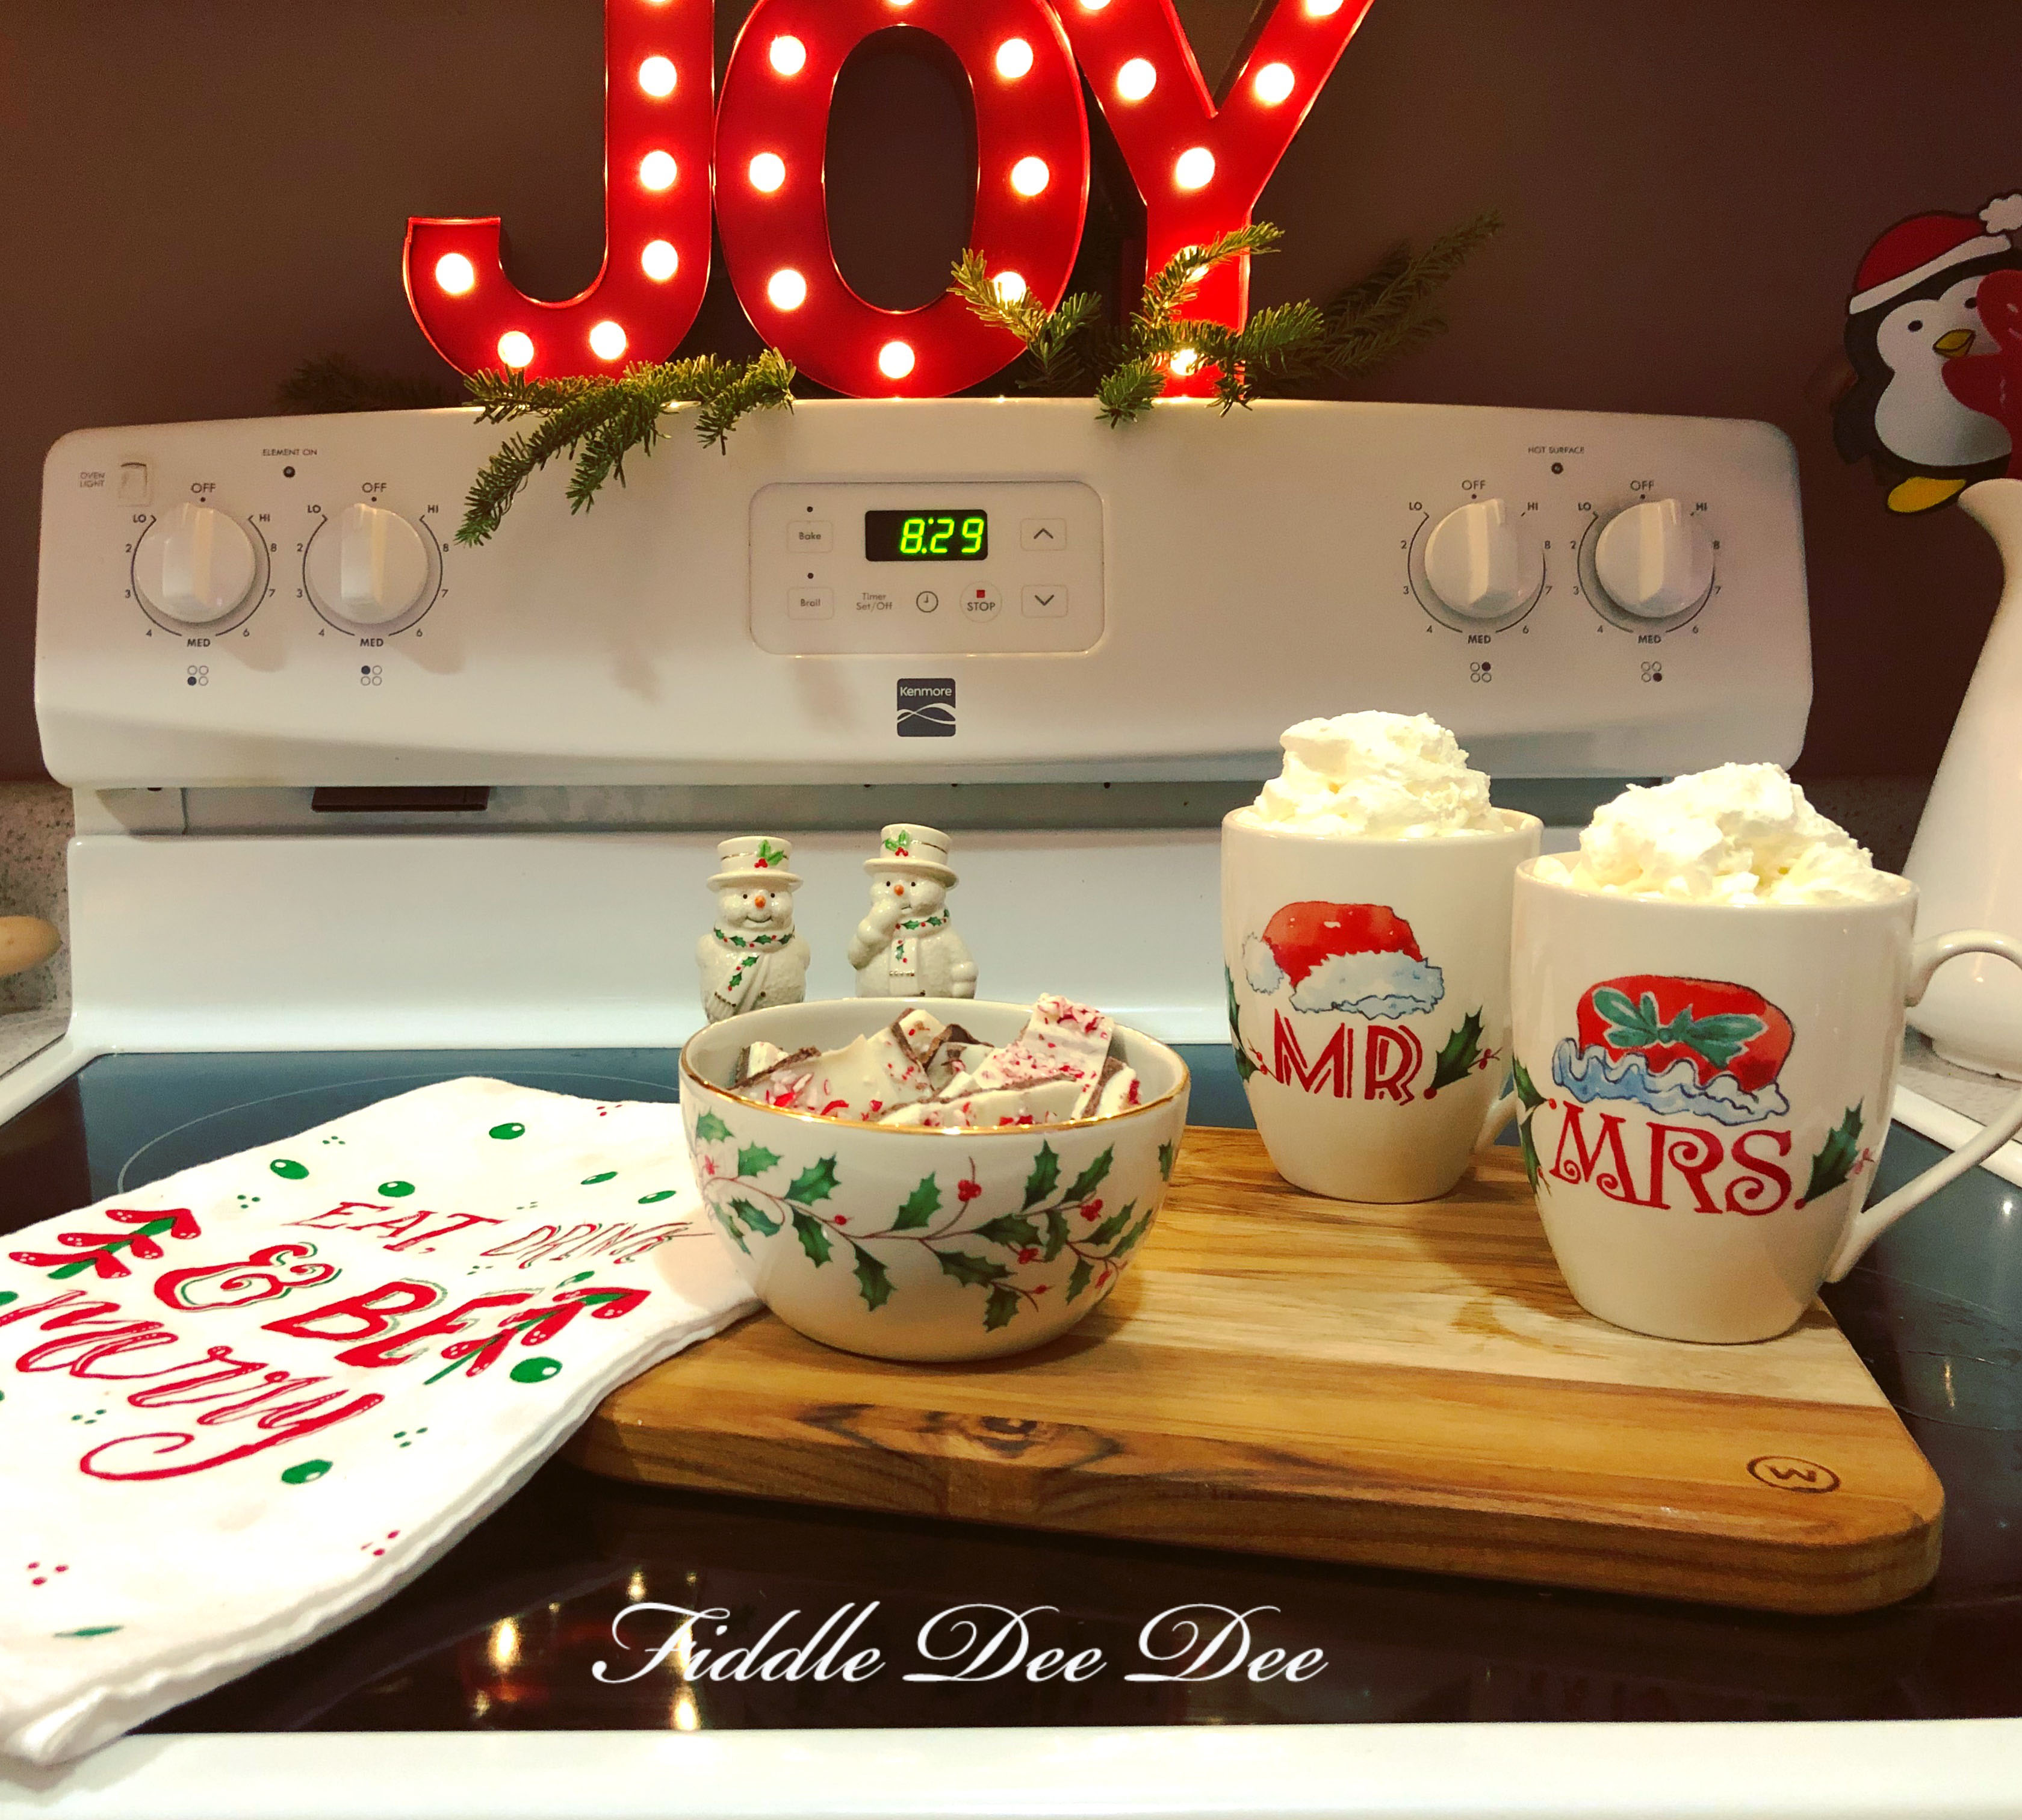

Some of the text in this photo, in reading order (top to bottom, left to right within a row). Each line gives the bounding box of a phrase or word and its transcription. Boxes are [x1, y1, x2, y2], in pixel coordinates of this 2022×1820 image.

[402, 0, 1375, 402] JOY
[190, 483, 216, 494] OFF
[362, 482, 386, 493] OFF
[1462, 480, 1486, 491] OFF
[1630, 480, 1654, 491] OFF
[308, 504, 321, 513] LO
[427, 505, 439, 513] HI
[1409, 501, 1422, 511] LO
[1527, 502, 1538, 510] HI
[1578, 502, 1592, 512] LO
[1696, 503, 1707, 511] HI
[133, 514, 146, 523] LO
[126, 543, 132, 552] 2
[270, 543, 277, 552] 8
[297, 543, 303, 552] 2
[443, 543, 449, 552] 8
[1401, 540, 1407, 549] 2
[1545, 540, 1551, 549] 8
[1571, 540, 1576, 549] 2
[1713, 540, 1719, 549] 8
[125, 589, 131, 598] 3
[269, 589, 276, 597] 7
[297, 589, 303, 598] 3
[441, 589, 448, 598] 7
[1403, 586, 1409, 595] 3
[1545, 586, 1552, 595] 7
[1573, 586, 1579, 595] 3
[1714, 586, 1721, 595] 7
[862, 592, 886, 601] Timer
[856, 601, 893, 611] Set/Off
[967, 602, 996, 611] STOP
[243, 628, 250, 637] 6
[318, 628, 324, 637] 4
[416, 628, 423, 637] 6
[1522, 625, 1529, 634] 6
[1692, 625, 1698, 634] 6
[187, 638, 211, 647] MED
[360, 638, 384, 647] MED
[1468, 634, 1491, 644] MED
[1638, 634, 1661, 643] MED
[900, 686, 952, 697] Kenmore
